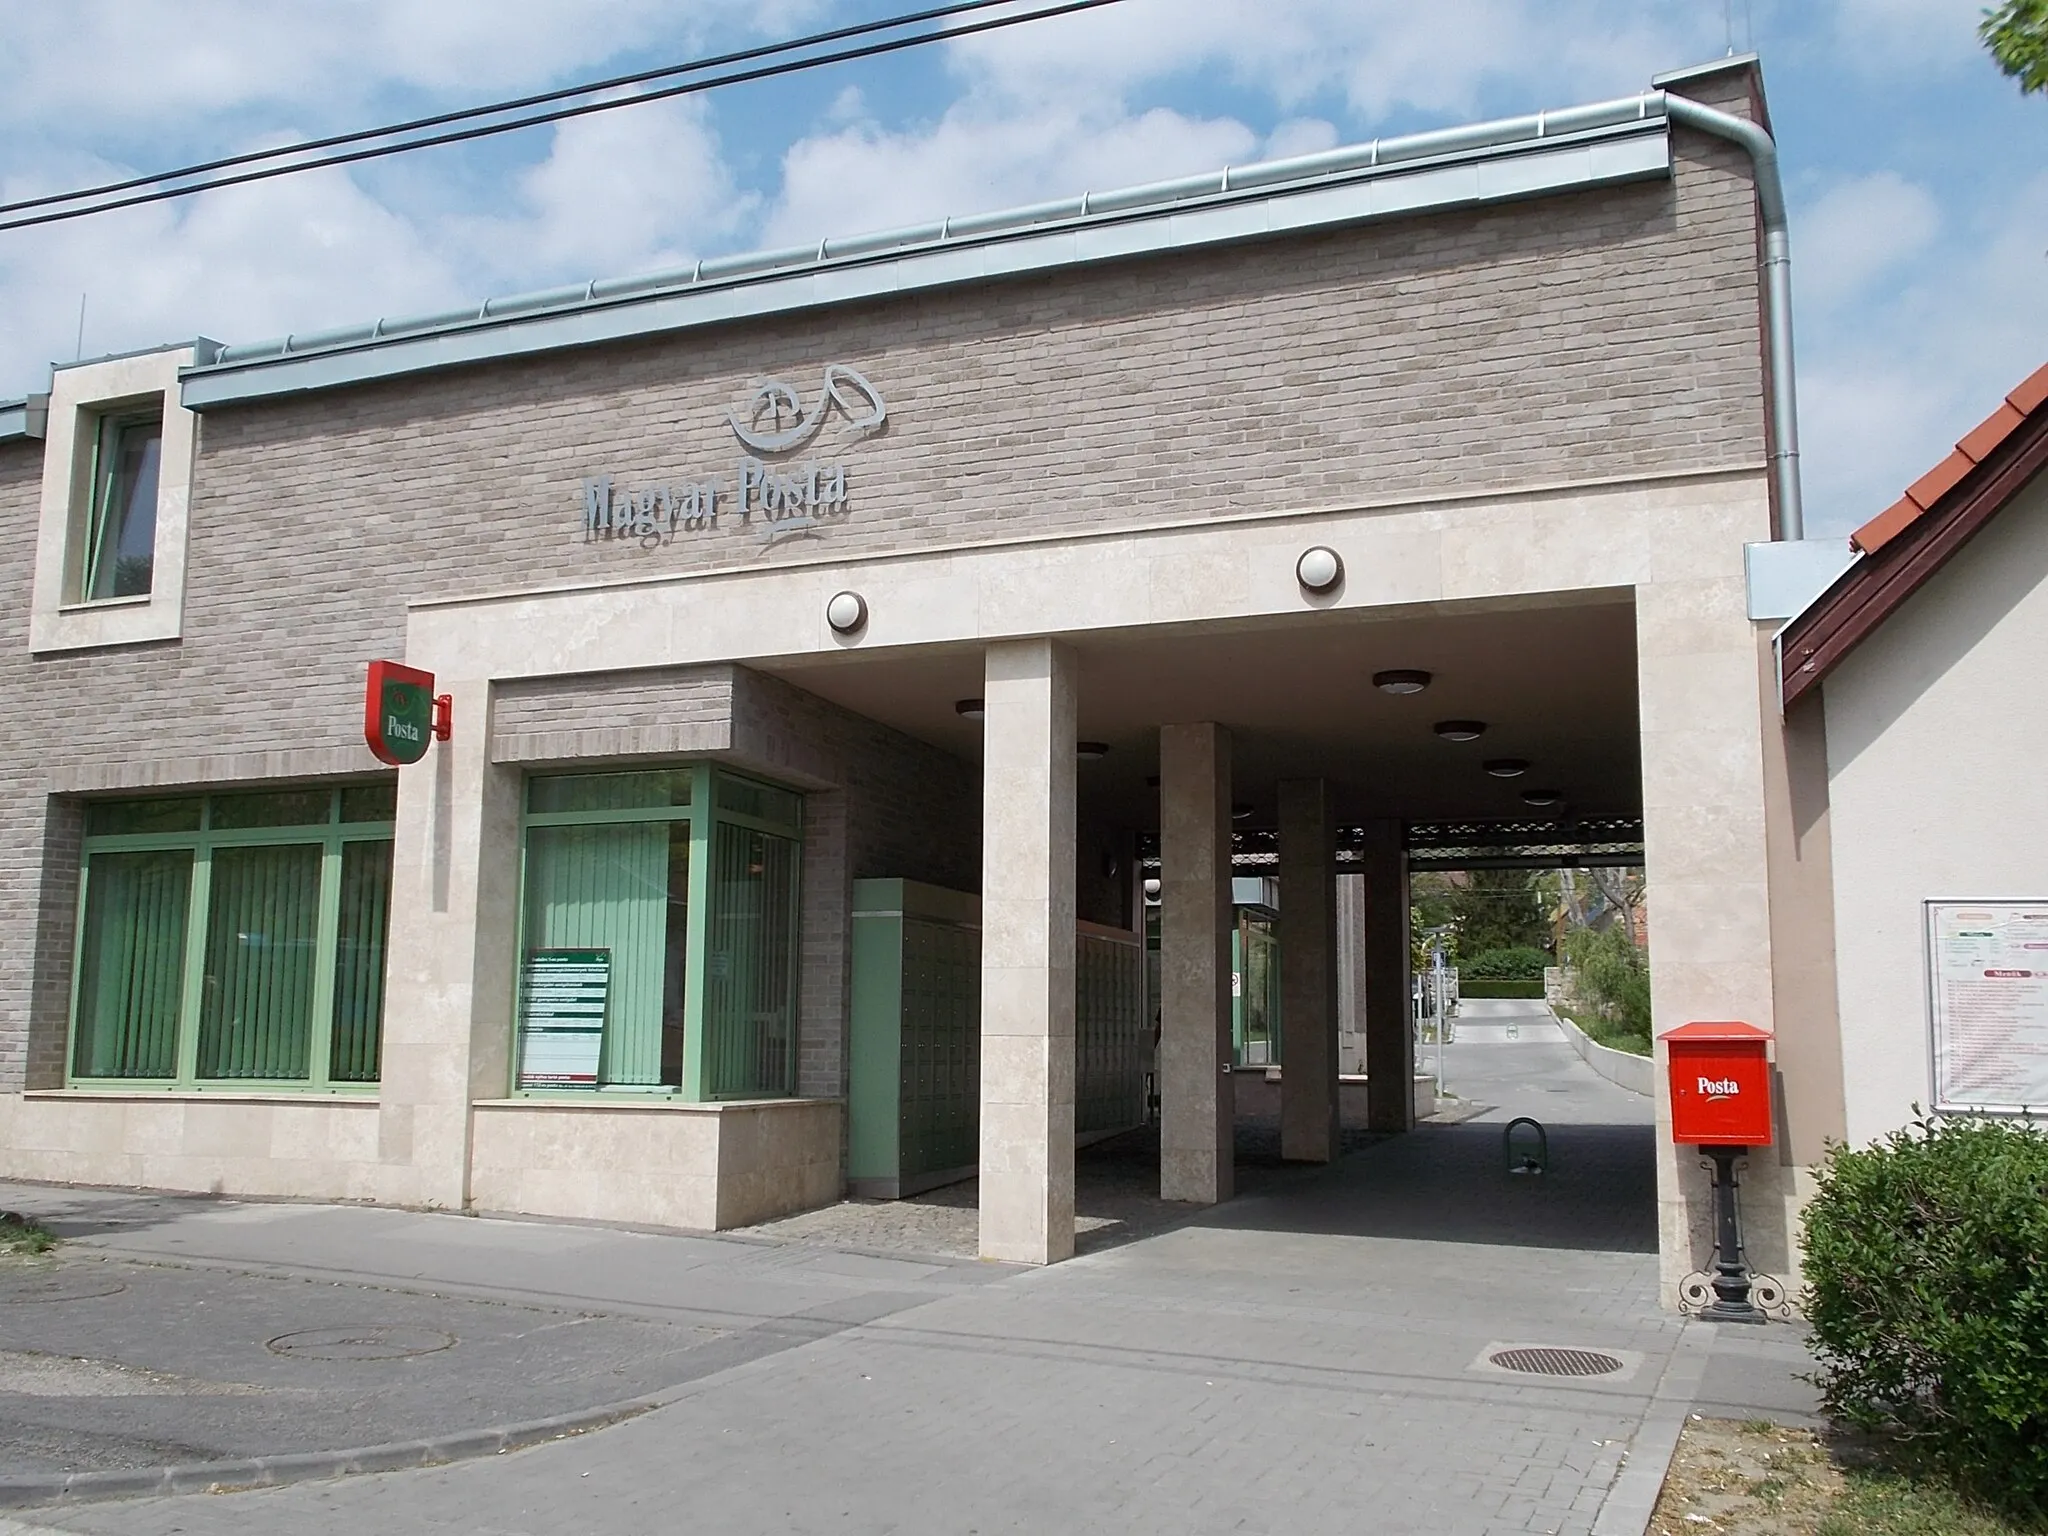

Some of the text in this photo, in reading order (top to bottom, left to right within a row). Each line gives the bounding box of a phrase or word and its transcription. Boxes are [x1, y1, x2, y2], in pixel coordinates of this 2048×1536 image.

[582, 455, 848, 535] Magyar Posta
[387, 715, 419, 742] Posta
[1697, 1076, 1740, 1095] Posta
